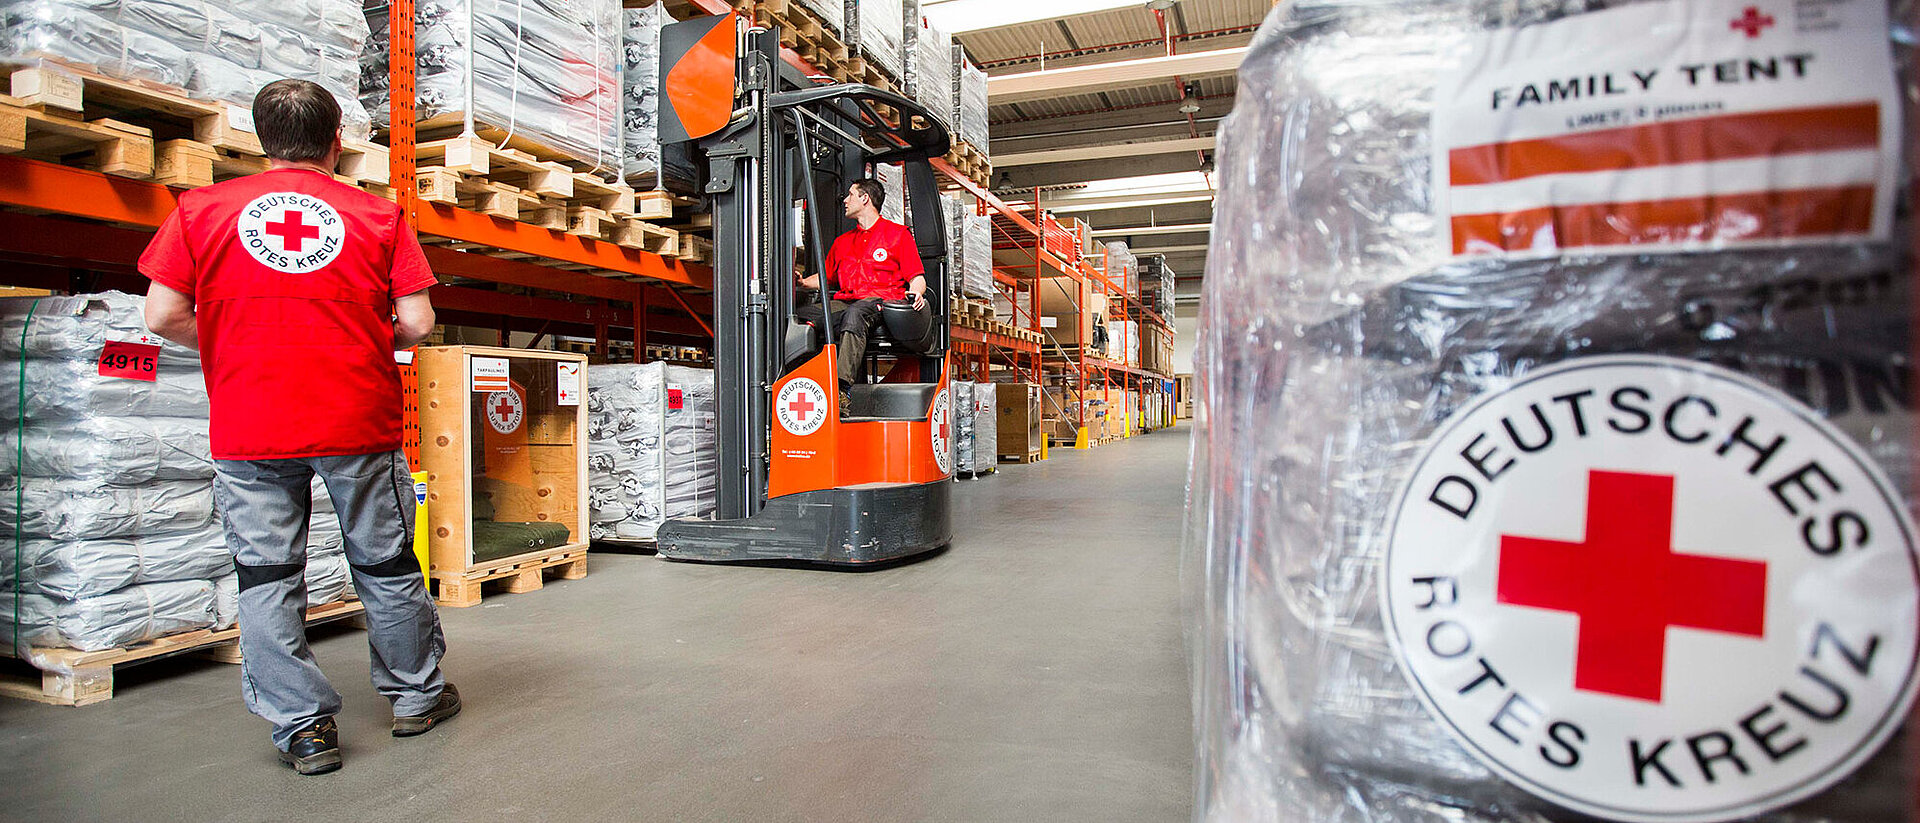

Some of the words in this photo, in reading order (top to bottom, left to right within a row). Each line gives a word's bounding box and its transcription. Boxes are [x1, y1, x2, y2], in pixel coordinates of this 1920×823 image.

[1491, 69, 1659, 110] FAMILY
[1679, 53, 1816, 87] TENT
[248, 195, 337, 226] DEUTSCHES
[245, 229, 288, 267] ROTES
[296, 236, 338, 269] KREUZ
[101, 354, 154, 372] 4915
[780, 381, 823, 402] DEUTSCHES
[780, 407, 800, 431] ROTES
[802, 408, 825, 431] KREUZ
[1429, 385, 1870, 558] DEUTSCHES
[1411, 575, 1588, 770] ROTES
[1628, 620, 1882, 790] KREUZ
